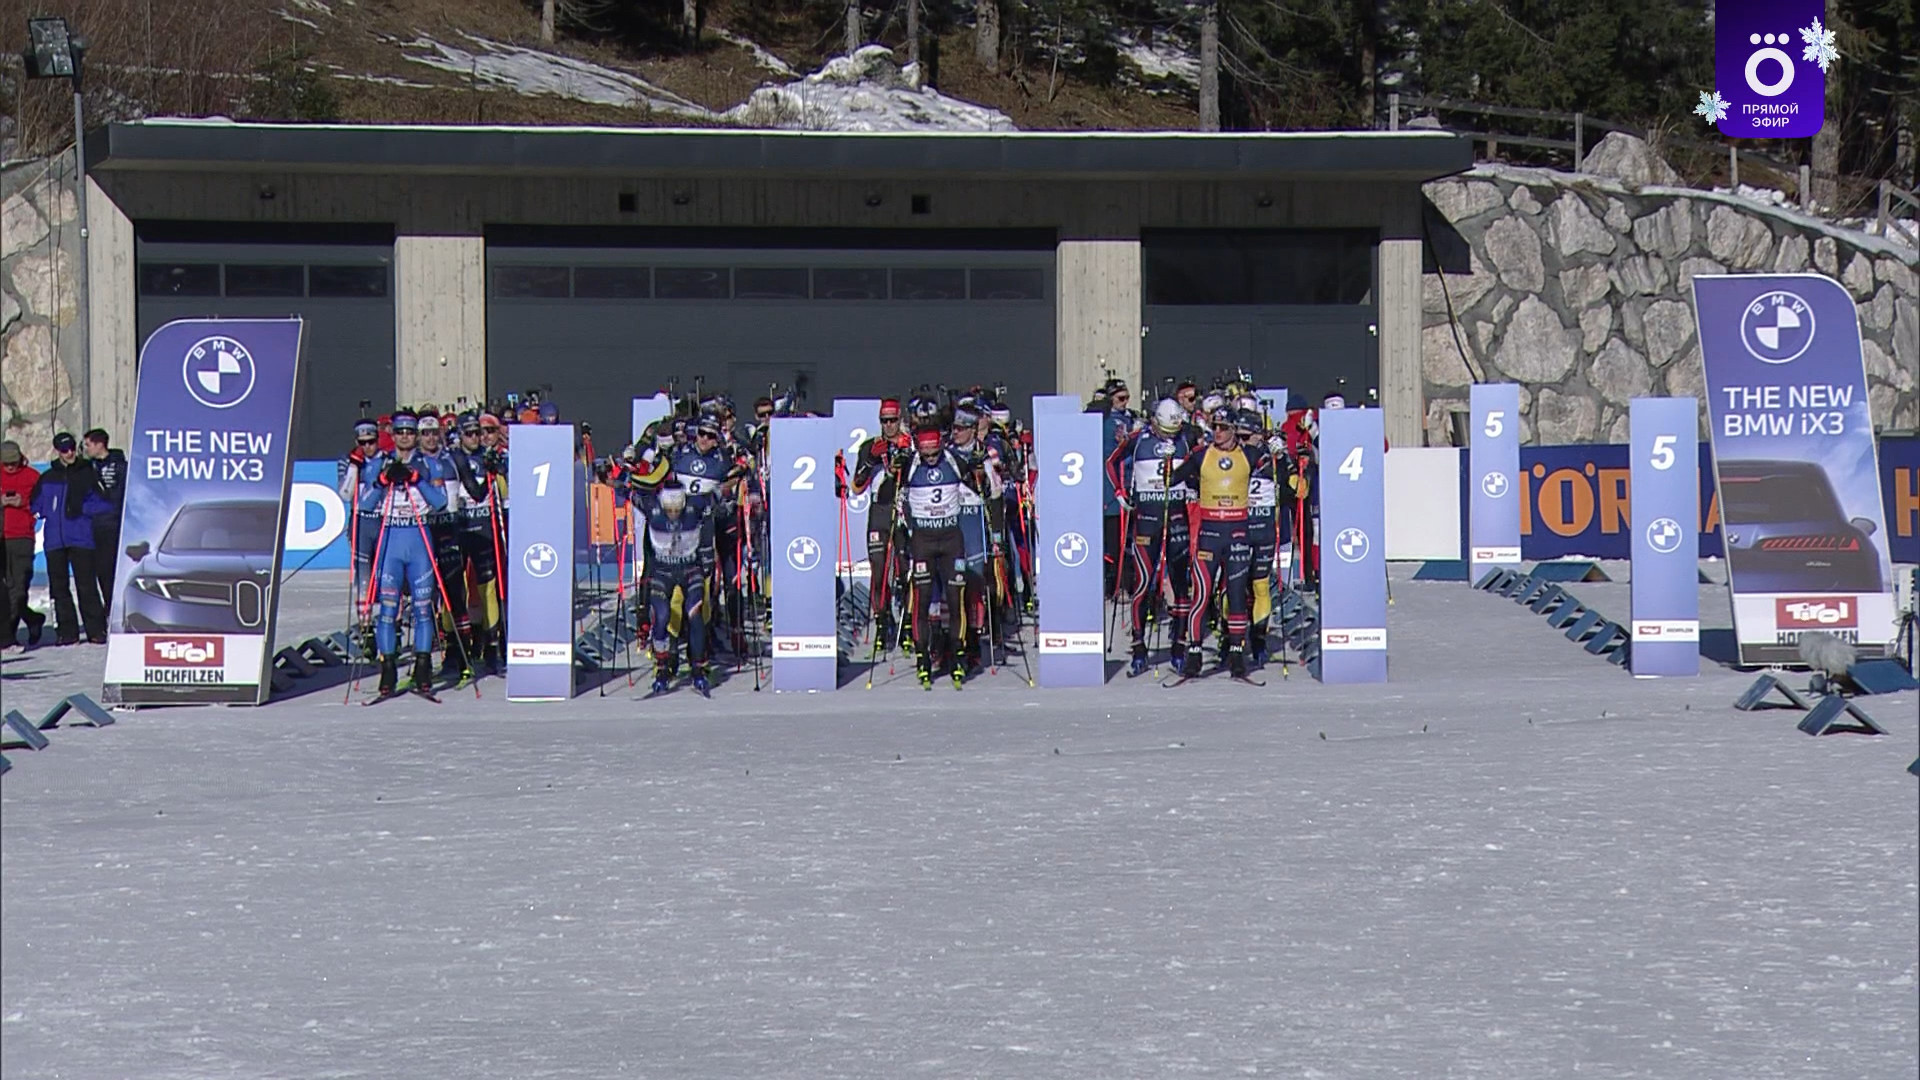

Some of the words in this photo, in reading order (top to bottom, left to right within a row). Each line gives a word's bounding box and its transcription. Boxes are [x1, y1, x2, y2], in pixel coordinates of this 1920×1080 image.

[1751, 295, 1805, 316] BMW
[193, 340, 246, 361] BMW
[1723, 386, 1781, 410] THE
[1788, 385, 1853, 409] NEW
[1484, 412, 1505, 438] 5
[1724, 413, 1795, 437] BMW
[1801, 412, 1845, 435] iX3
[145, 430, 202, 454] THE
[209, 431, 273, 455] NEW
[847, 428, 867, 454] 2
[1650, 436, 1677, 470] 5
[147, 457, 216, 480] BMW
[222, 459, 264, 482] iX3
[790, 456, 817, 490] 2
[1059, 452, 1085, 486] 3
[1338, 447, 1364, 481] 4
[532, 463, 551, 497] 1
[689, 479, 701, 494] 6
[1251, 480, 1262, 495] 2
[931, 488, 943, 504] 3
[1139, 491, 1165, 502] BMW
[1786, 601, 1849, 624] Tirol
[154, 641, 215, 663] Tirol
[144, 669, 224, 682] HOCHFILZEN
